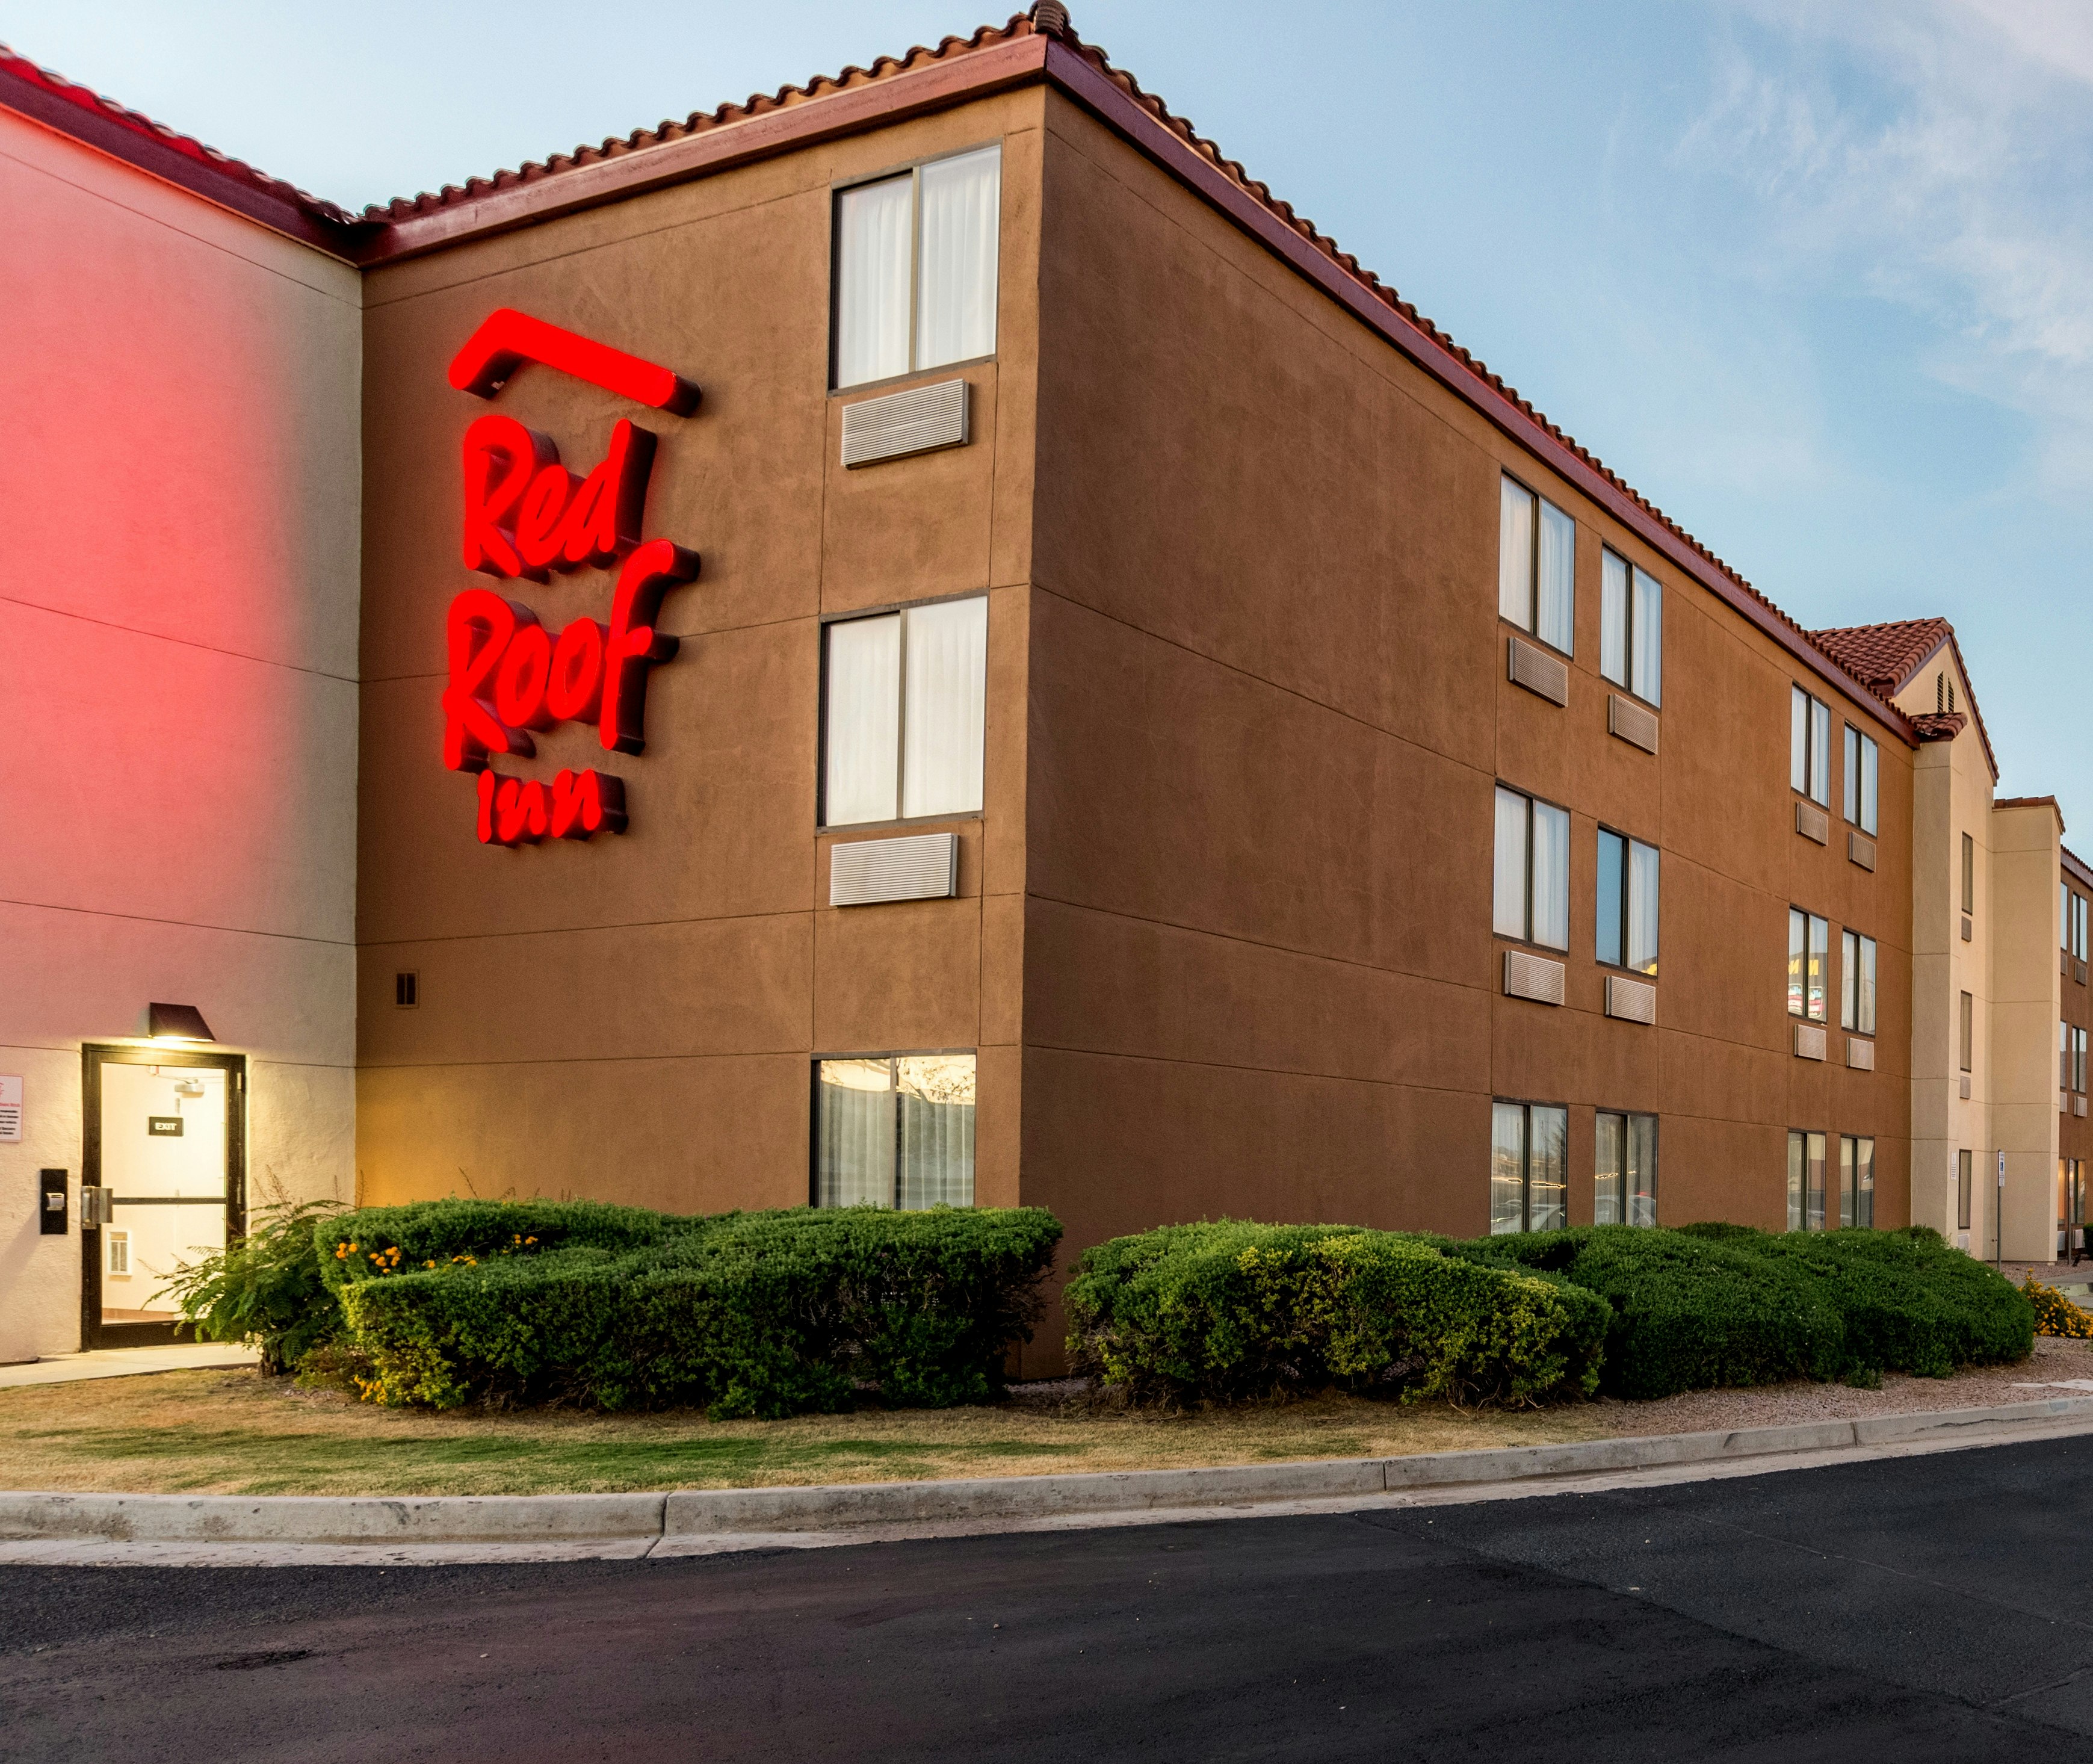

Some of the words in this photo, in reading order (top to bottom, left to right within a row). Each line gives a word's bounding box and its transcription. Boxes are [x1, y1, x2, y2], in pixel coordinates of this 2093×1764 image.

[463, 415, 633, 578] Red
[443, 539, 675, 772] Roof
[155, 1122, 178, 1131] EXIT
